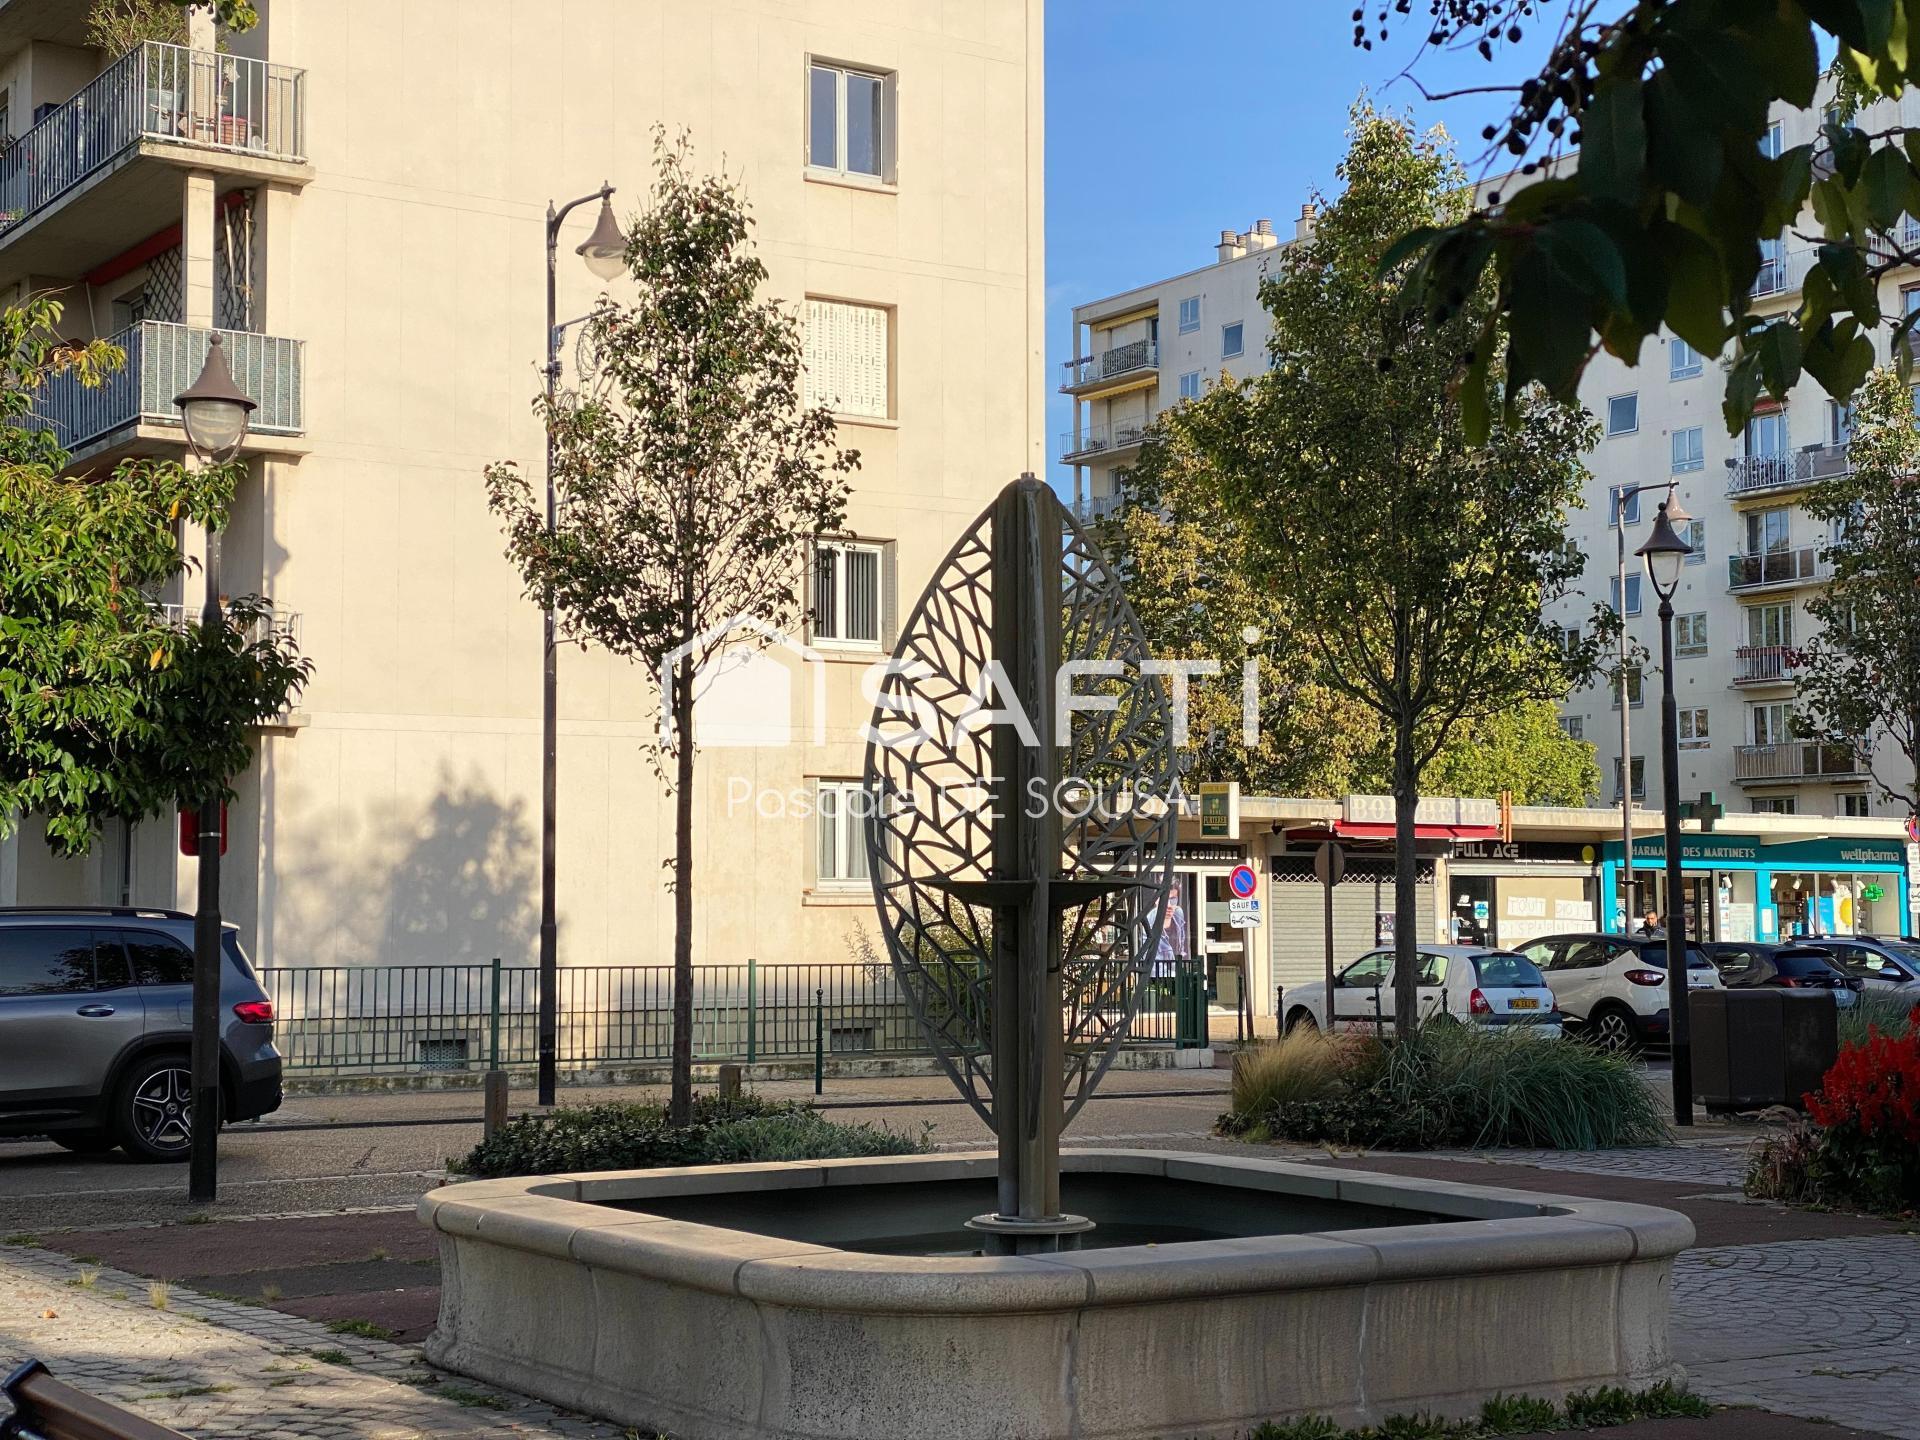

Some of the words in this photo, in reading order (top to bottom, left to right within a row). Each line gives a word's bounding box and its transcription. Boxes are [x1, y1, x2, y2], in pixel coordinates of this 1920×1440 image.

[1455, 843, 1488, 857] FULL
[1492, 844, 1519, 858] ACE
[1682, 846, 1701, 857] DES
[1703, 847, 1756, 858] MARTINETS
[1840, 848, 1900, 863] wellpharma
[1232, 901, 1249, 910] SAUF
